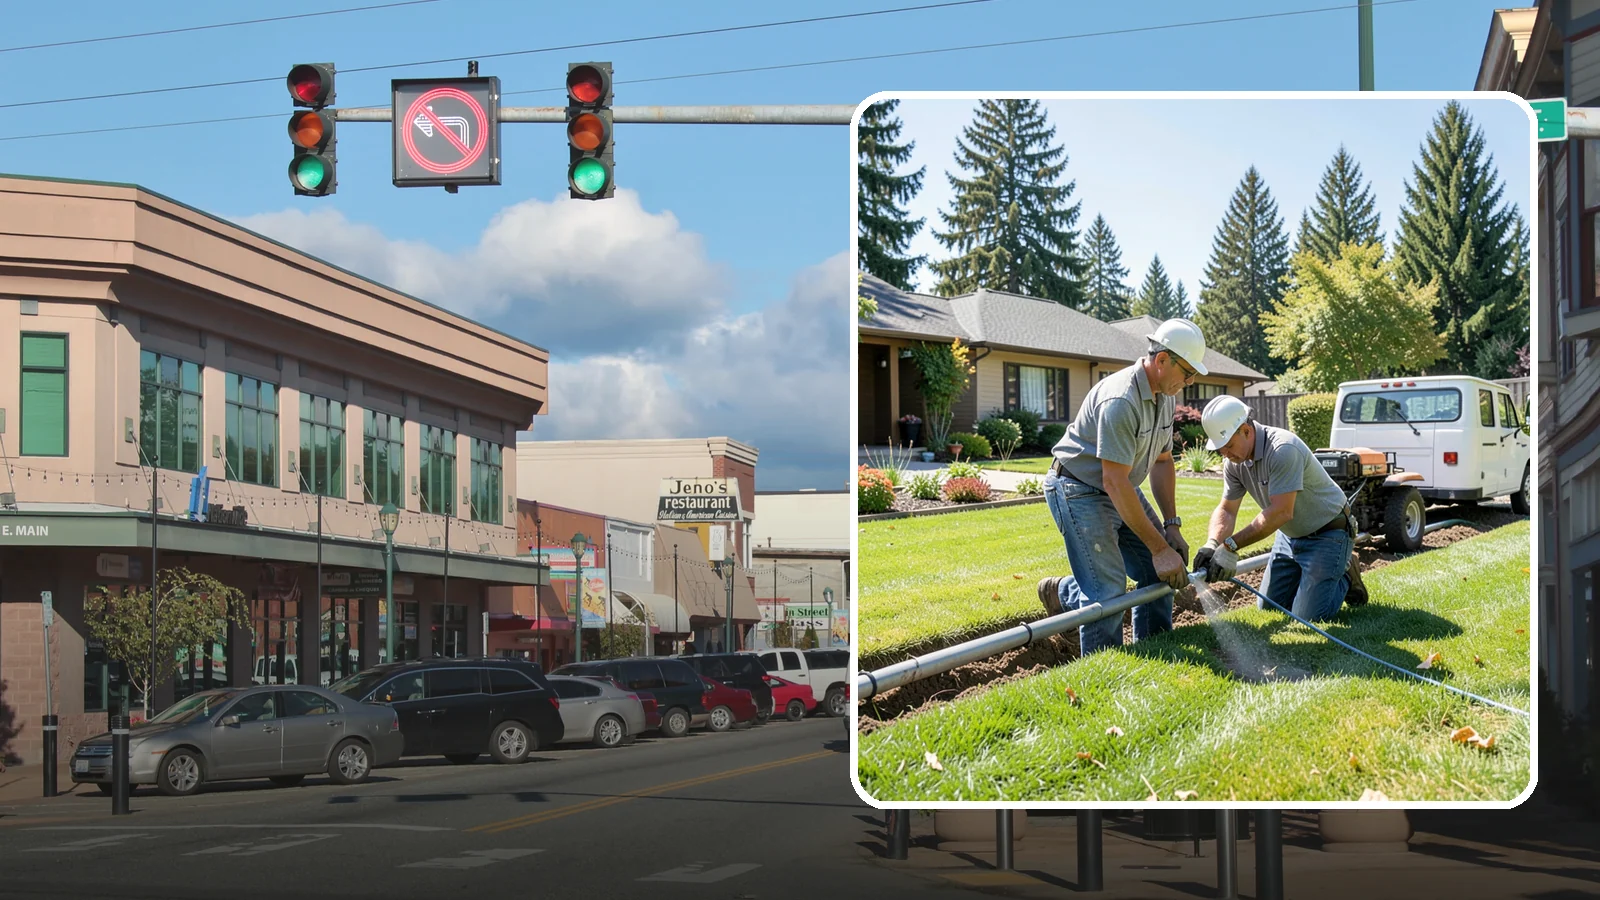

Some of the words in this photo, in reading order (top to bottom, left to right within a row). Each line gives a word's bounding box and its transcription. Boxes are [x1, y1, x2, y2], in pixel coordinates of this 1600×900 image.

[670, 480, 727, 494] Jeno's
[665, 497, 730, 509] restaurant
[686, 510, 714, 519] American
[715, 510, 737, 519] Cuisine
[2, 525, 13, 536] E.
[15, 525, 48, 536] MAIN
[797, 607, 828, 616] Street
